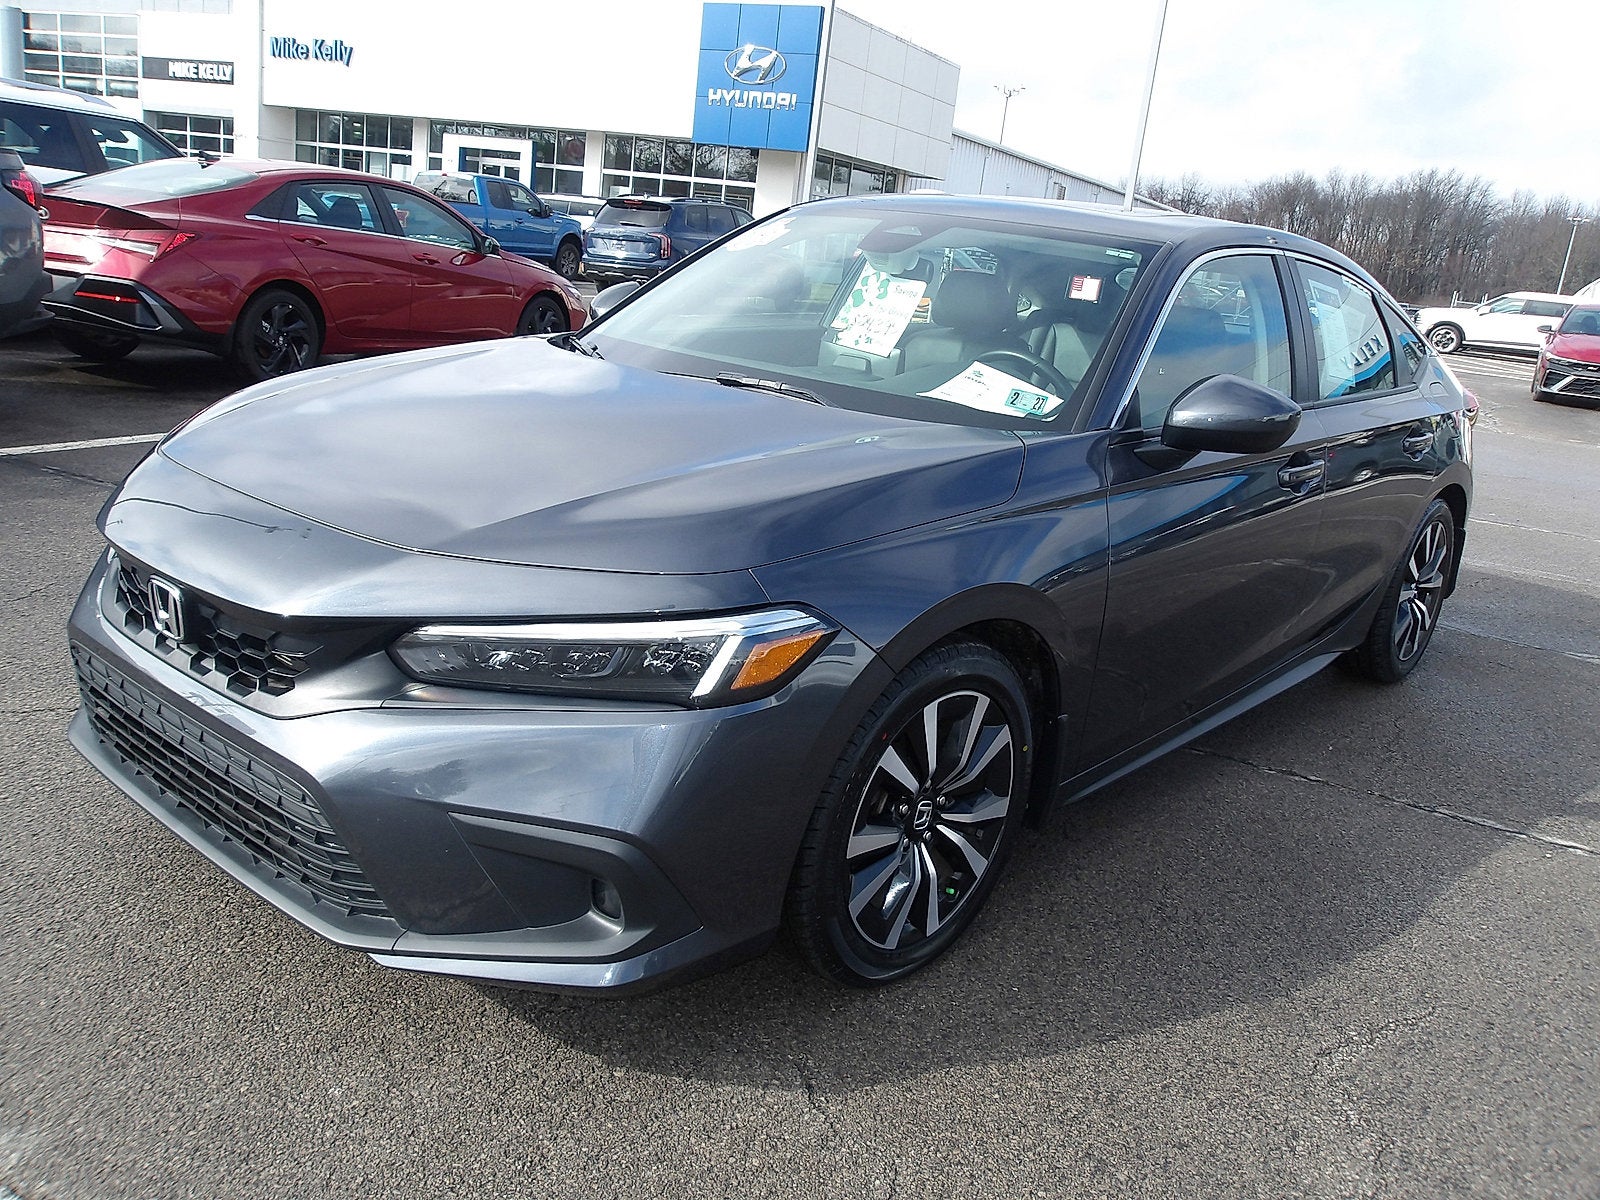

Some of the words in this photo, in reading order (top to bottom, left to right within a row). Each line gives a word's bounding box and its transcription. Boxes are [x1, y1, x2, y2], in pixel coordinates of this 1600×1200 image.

[269, 36, 310, 60] Mike
[312, 38, 354, 68] Kelly
[168, 61, 198, 79] MIKE
[198, 62, 233, 82] KELLY
[707, 87, 798, 111] HYUNDAI
[1032, 396, 1046, 411] 27
